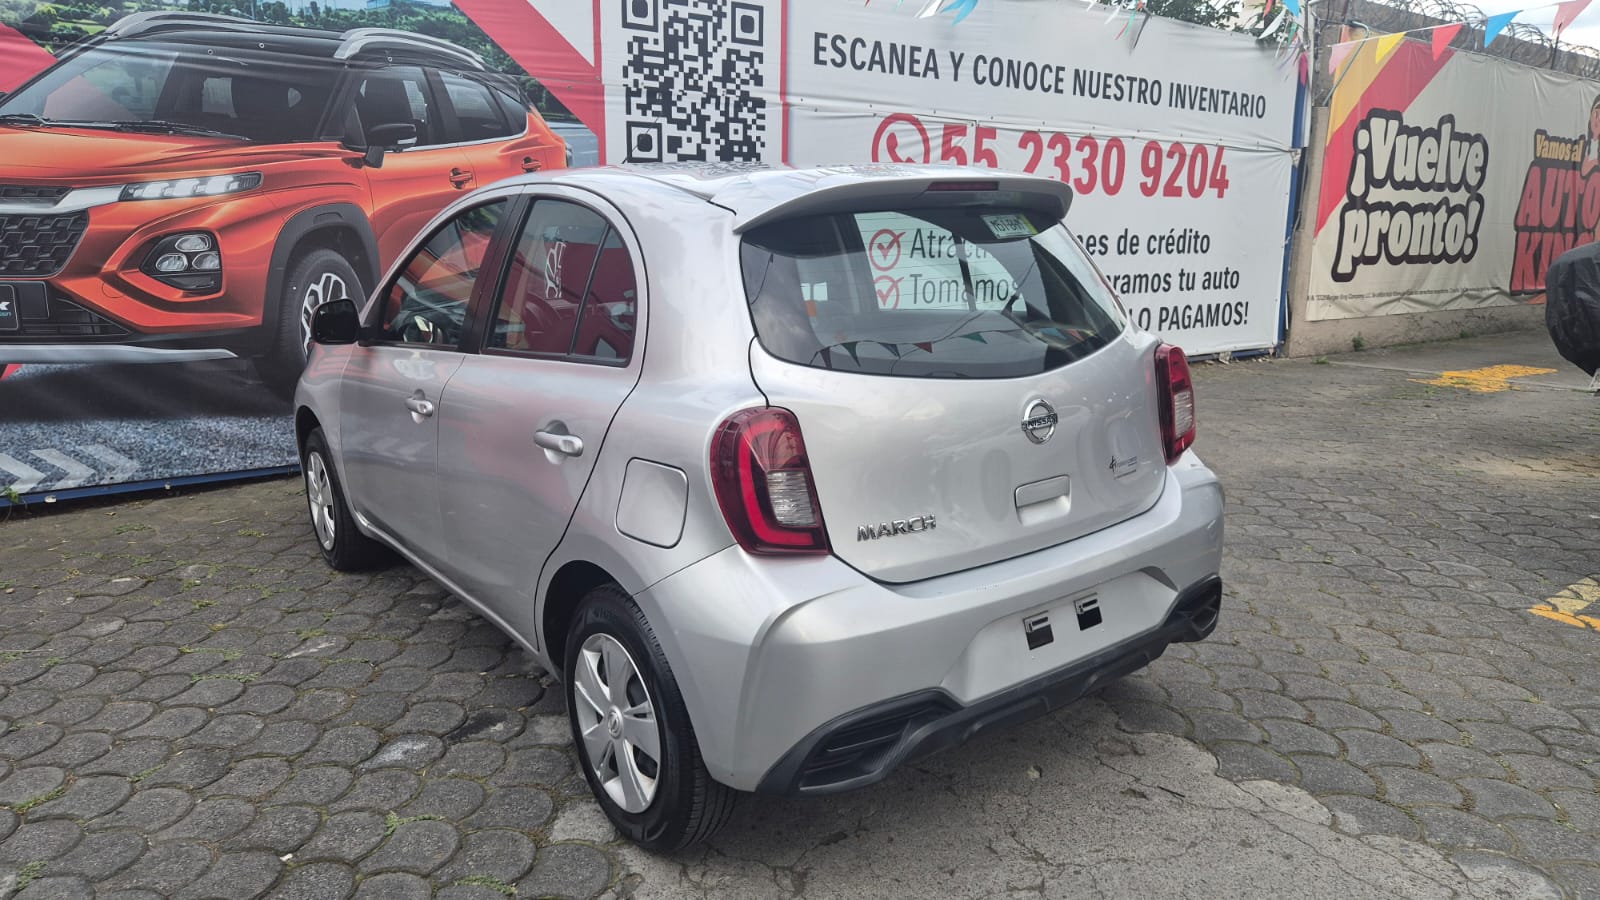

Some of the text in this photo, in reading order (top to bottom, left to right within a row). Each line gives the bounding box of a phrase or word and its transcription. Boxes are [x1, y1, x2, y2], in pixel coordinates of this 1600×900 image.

[813, 31, 1266, 119] ESCANEA Y CONOCE NUESTRO INVENTARIO
[940, 123, 1230, 199] 55 2330 9204
[1349, 114, 1486, 199] ¡Vuelve
[1536, 134, 1585, 162] Vamos al
[1515, 165, 1600, 229] AUTO
[1117, 228, 1140, 255] de
[1147, 228, 1211, 255] crédito
[1335, 199, 1482, 276] pronto!
[1106, 272, 1172, 295] ramos
[1178, 268, 1196, 292] tu
[1202, 266, 1240, 291] auto
[1128, 301, 1249, 332] O PAGAMOS!
[1027, 414, 1057, 428] NISSAN
[857, 514, 937, 542] MARCH
